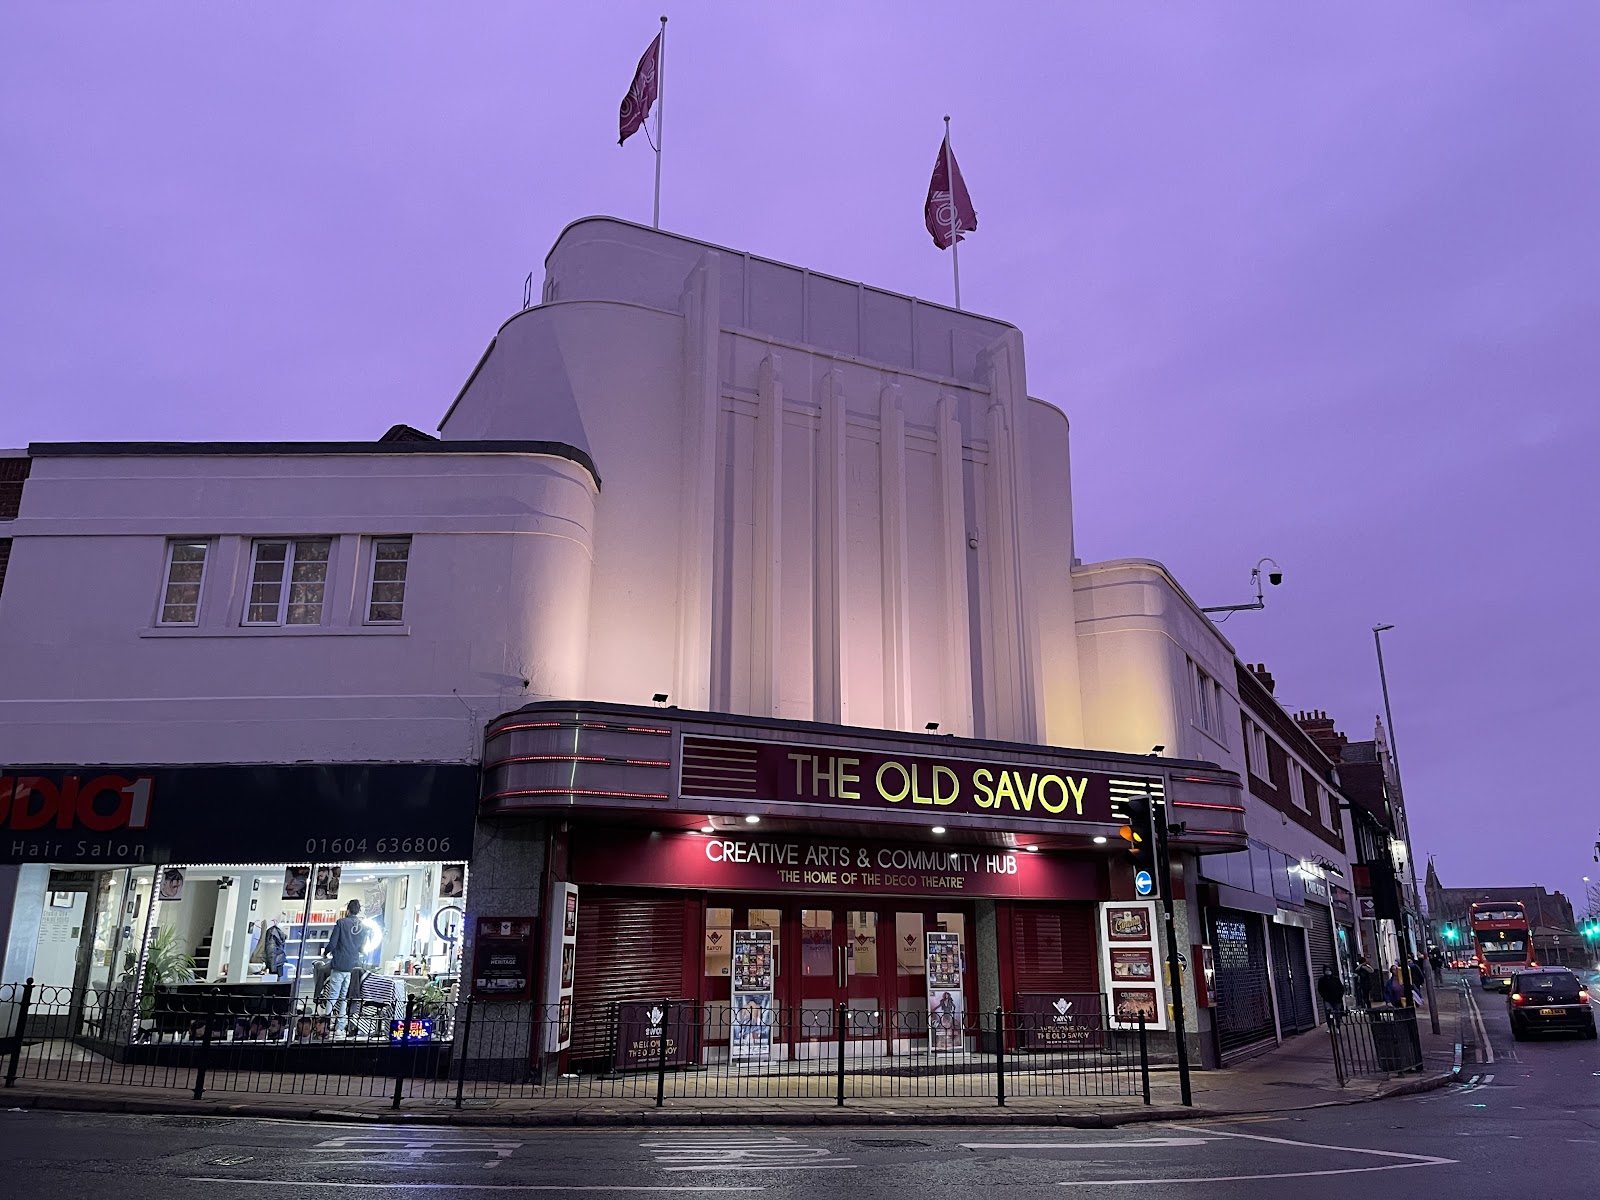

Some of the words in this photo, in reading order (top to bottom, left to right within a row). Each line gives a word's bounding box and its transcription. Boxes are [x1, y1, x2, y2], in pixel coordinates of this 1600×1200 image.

[787, 752, 861, 800] THE
[875, 760, 960, 806] OLD
[972, 768, 1089, 815] SAVOY
[0, 774, 156, 831] DIO1
[11, 840, 62, 856] Hair
[75, 840, 145, 856] Salon
[305, 838, 367, 853] 01604
[376, 837, 450, 853] 636806
[705, 840, 799, 865] CREATIVE
[804, 845, 850, 867] ARTS
[856, 848, 871, 868] &
[877, 849, 980, 873] COMMUNITY
[986, 854, 1017, 874] HUB
[804, 871, 837, 884] HOME
[841, 872, 858, 884] OF
[861, 873, 881, 885] THE
[884, 874, 916, 886] DECO
